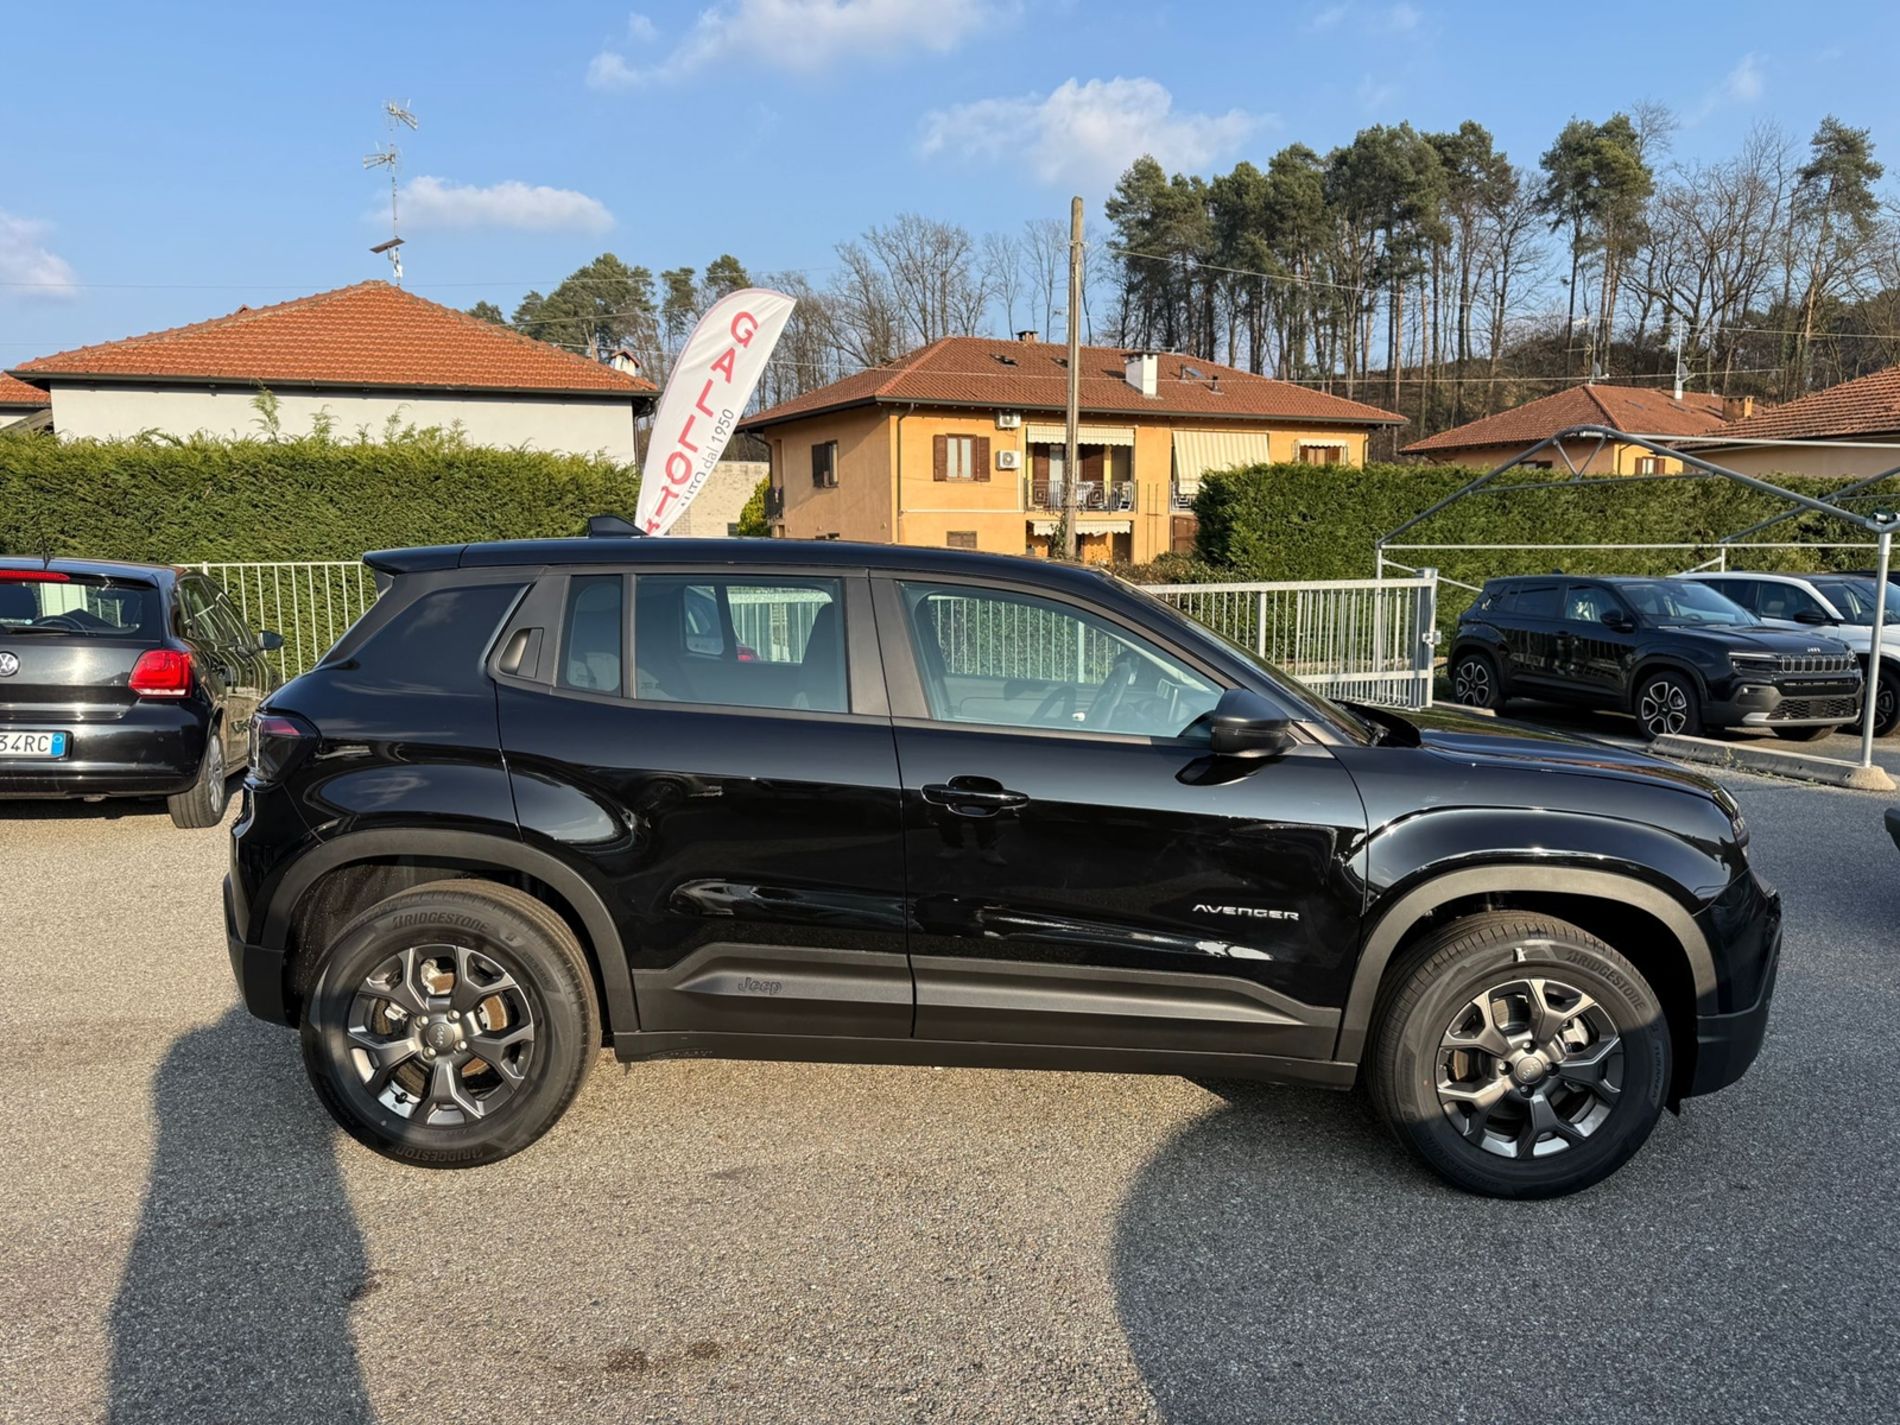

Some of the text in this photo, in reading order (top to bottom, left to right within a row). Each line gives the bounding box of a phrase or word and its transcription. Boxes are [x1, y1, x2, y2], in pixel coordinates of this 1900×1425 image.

[702, 445, 719, 469] dal
[711, 408, 735, 443] 1950
[392, 911, 490, 932] BRIDGESTONE
[1192, 904, 1299, 920] AVENGER
[738, 976, 782, 995] Jeep
[1565, 951, 1646, 1010] BRIDGESTONE
